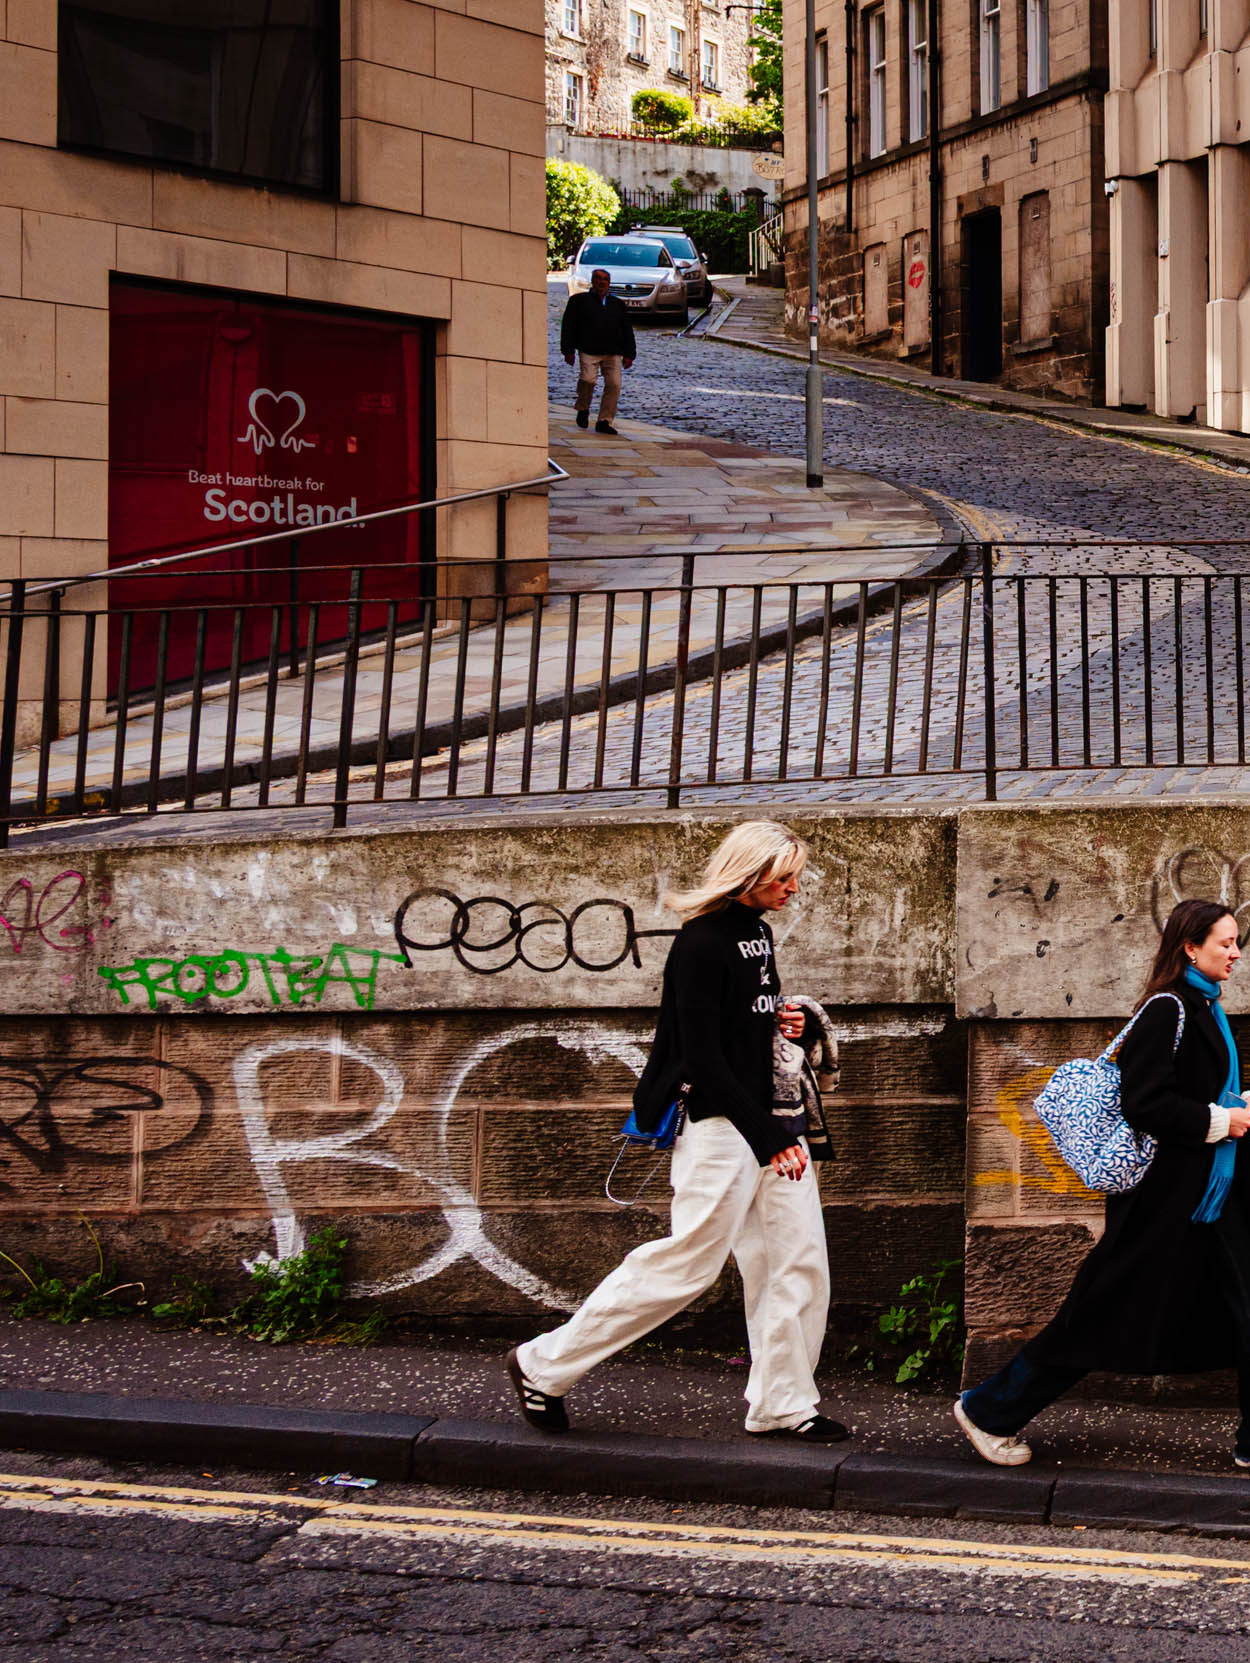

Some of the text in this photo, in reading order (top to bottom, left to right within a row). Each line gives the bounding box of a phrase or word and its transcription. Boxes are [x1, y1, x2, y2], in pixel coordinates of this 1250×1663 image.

[188, 470, 325, 492] Beat heartbreak for
[203, 488, 366, 528] Scotland.
